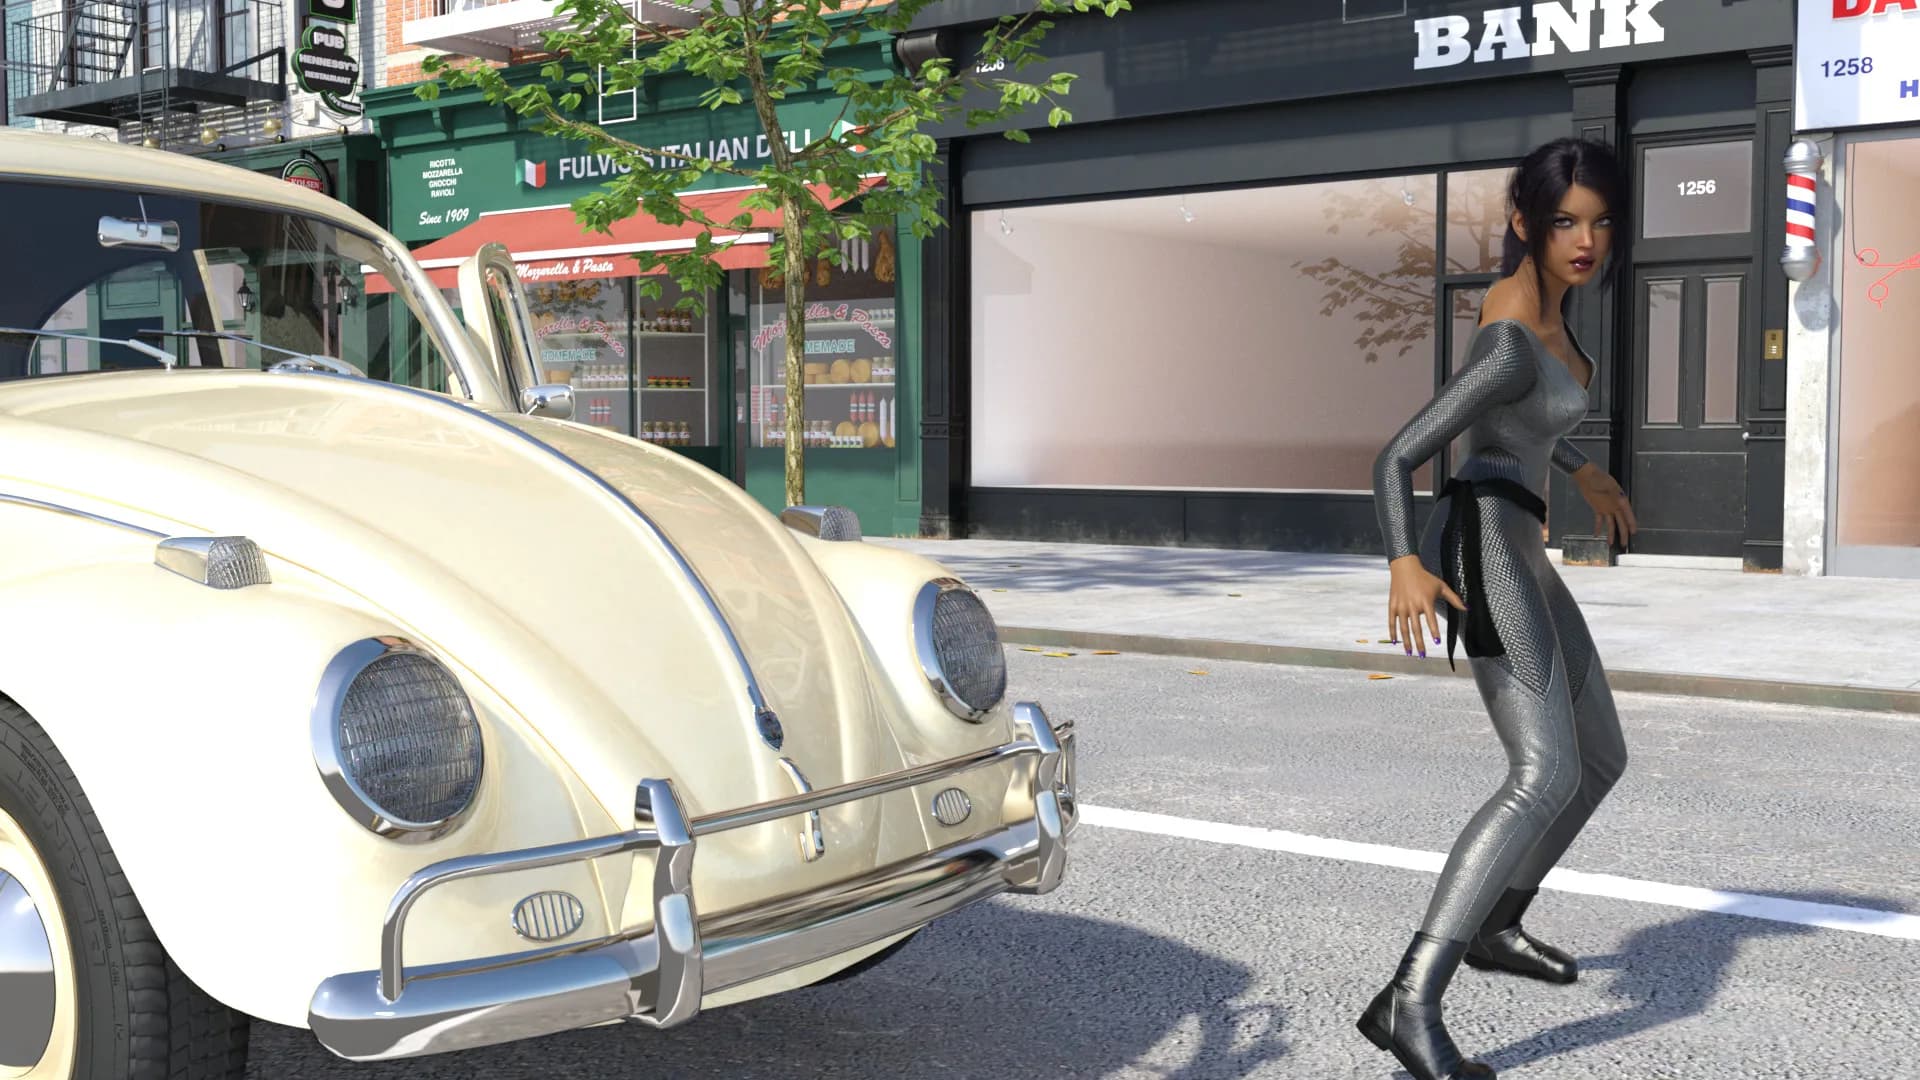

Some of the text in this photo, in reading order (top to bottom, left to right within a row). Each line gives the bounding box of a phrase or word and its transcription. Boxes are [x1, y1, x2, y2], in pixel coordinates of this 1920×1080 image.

[313, 31, 345, 50] PUB
[1414, 0, 1665, 71] BANK
[1821, 56, 1873, 78] 1258
[756, 128, 811, 159] DLI
[422, 167, 463, 179] MOZZARELLA
[429, 158, 456, 169] RICOTTA
[428, 178, 457, 189] GNOCCHI
[431, 188, 455, 198] RAVIOLI
[1677, 179, 1716, 196] 1256
[419, 207, 470, 226] Since 1909
[515, 258, 614, 281] Mozzarella & Pasta
[833, 303, 848, 319] &
[850, 307, 892, 349] Pasta
